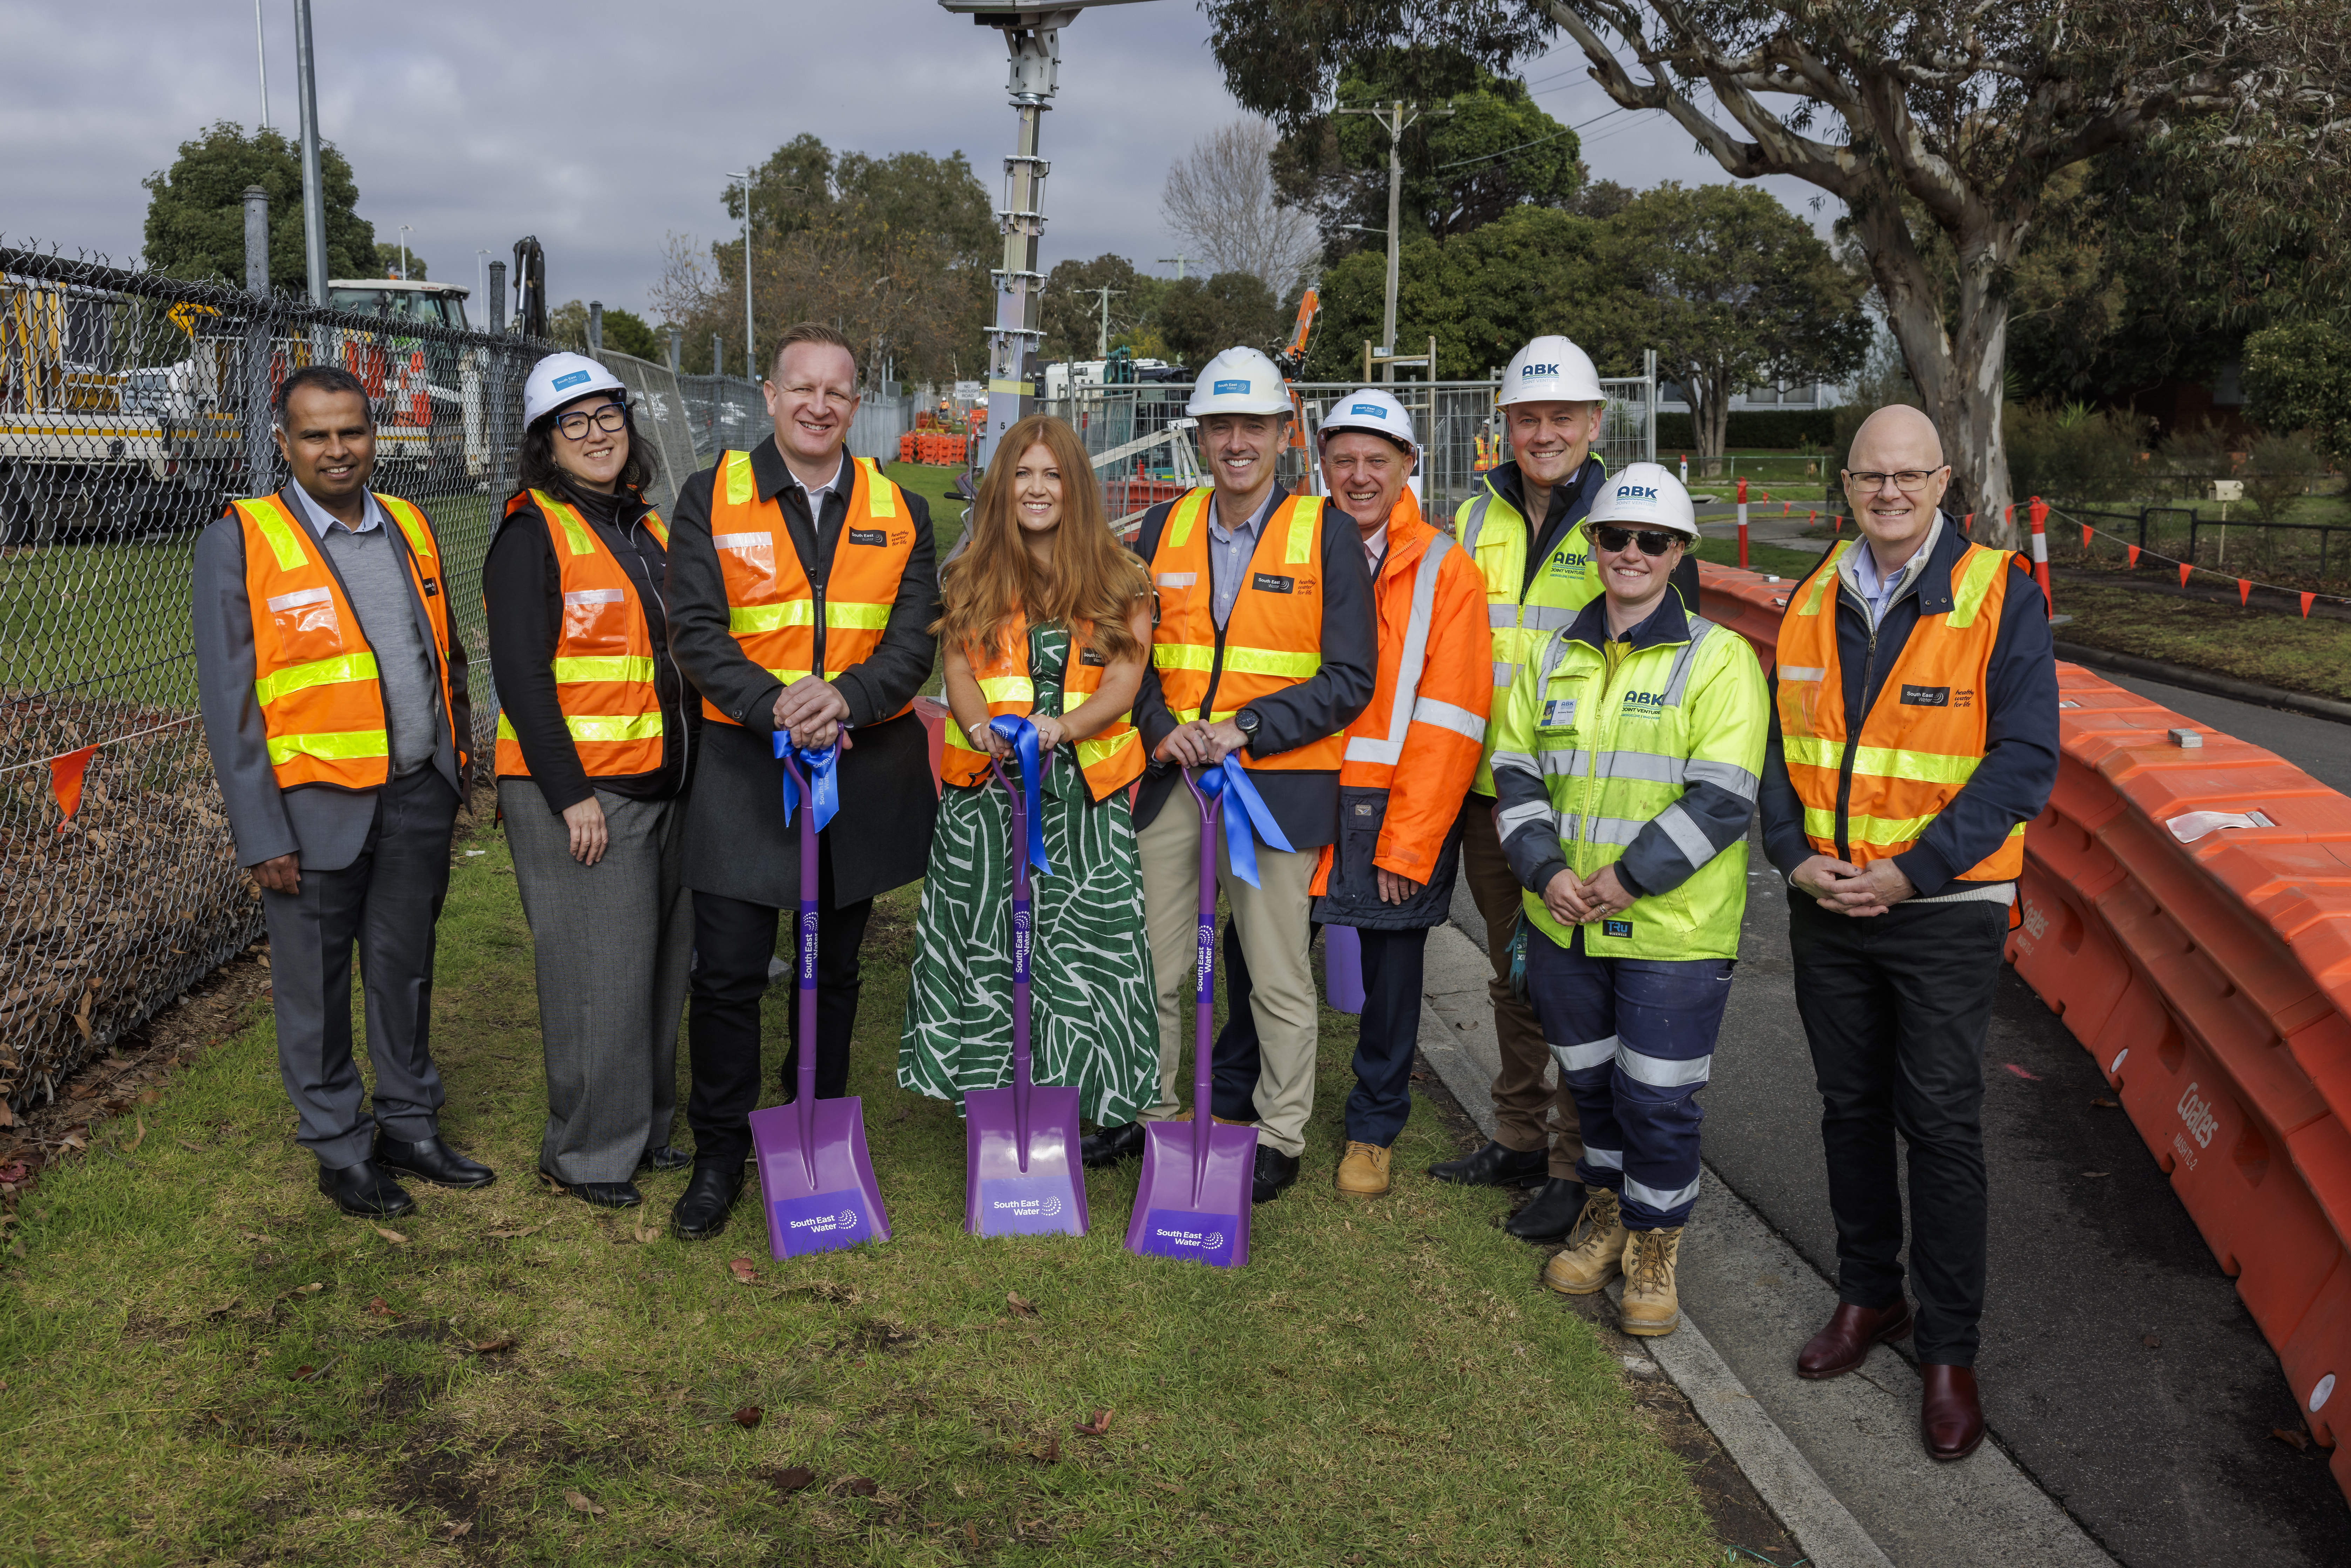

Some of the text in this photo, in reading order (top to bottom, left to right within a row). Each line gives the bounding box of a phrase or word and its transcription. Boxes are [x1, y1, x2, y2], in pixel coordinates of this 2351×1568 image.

[1522, 364, 1560, 376] ABK
[1617, 486, 1659, 499] ABK
[1553, 551, 1587, 566] ABK
[1624, 691, 1665, 706] ABK
[813, 758, 831, 768] South
[2177, 1082, 2219, 1148] Coates
[2173, 1132, 2197, 1171] MASH TL-2
[790, 1215, 835, 1228] South East
[810, 1223, 837, 1233] Water
[1156, 1229, 1202, 1239] South East
[1175, 1238, 1201, 1246] Water
